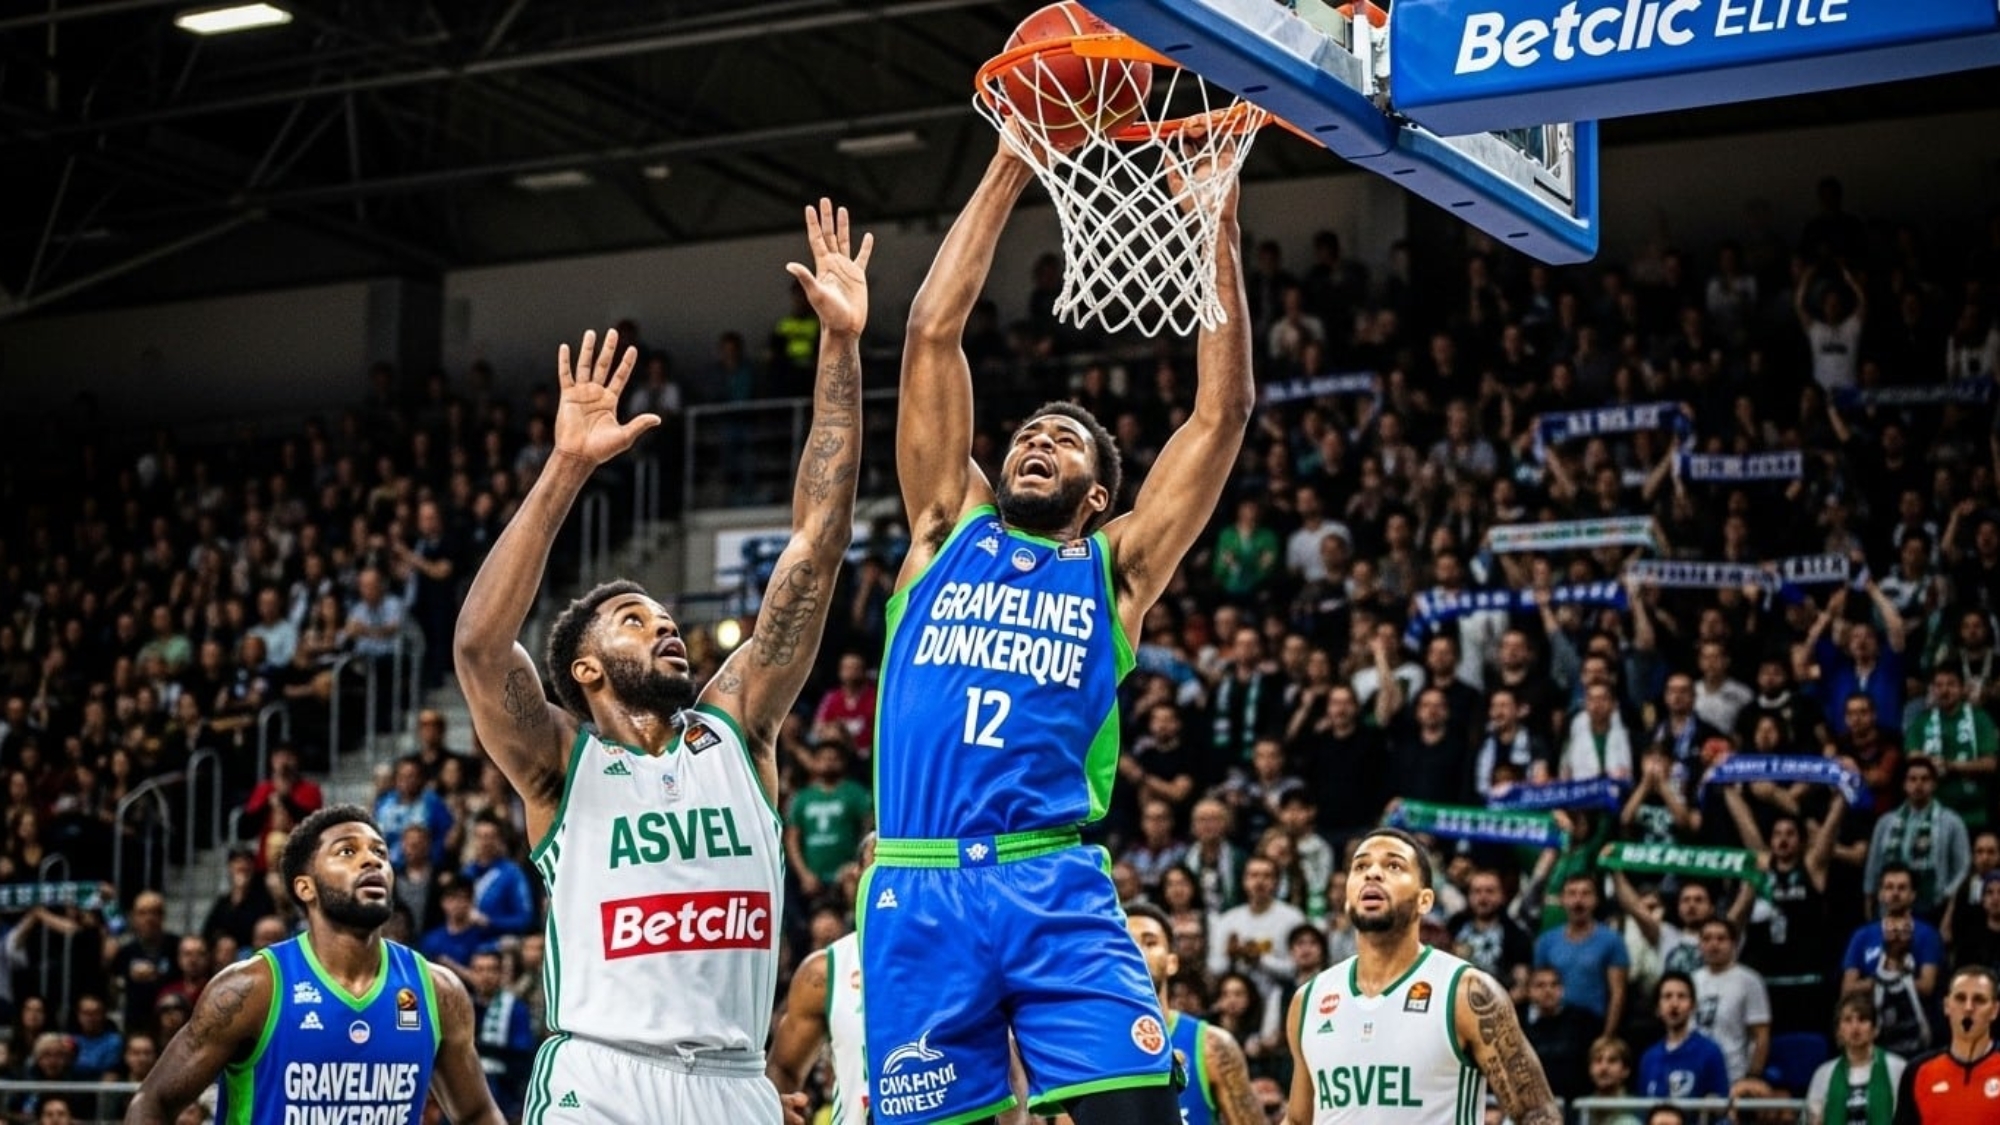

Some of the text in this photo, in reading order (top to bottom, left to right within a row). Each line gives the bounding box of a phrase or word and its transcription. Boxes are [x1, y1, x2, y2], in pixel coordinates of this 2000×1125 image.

[1454, 0, 1701, 75] Betclic
[931, 582, 1096, 640] GRAVELINES
[913, 625, 1087, 688] DUNKERQUE
[963, 687, 1011, 748] 12
[610, 807, 752, 869] ASVEL
[611, 897, 767, 950] Betclic
[285, 1061, 419, 1101] GRAVELINES
[1317, 1065, 1423, 1109] ASVEL
